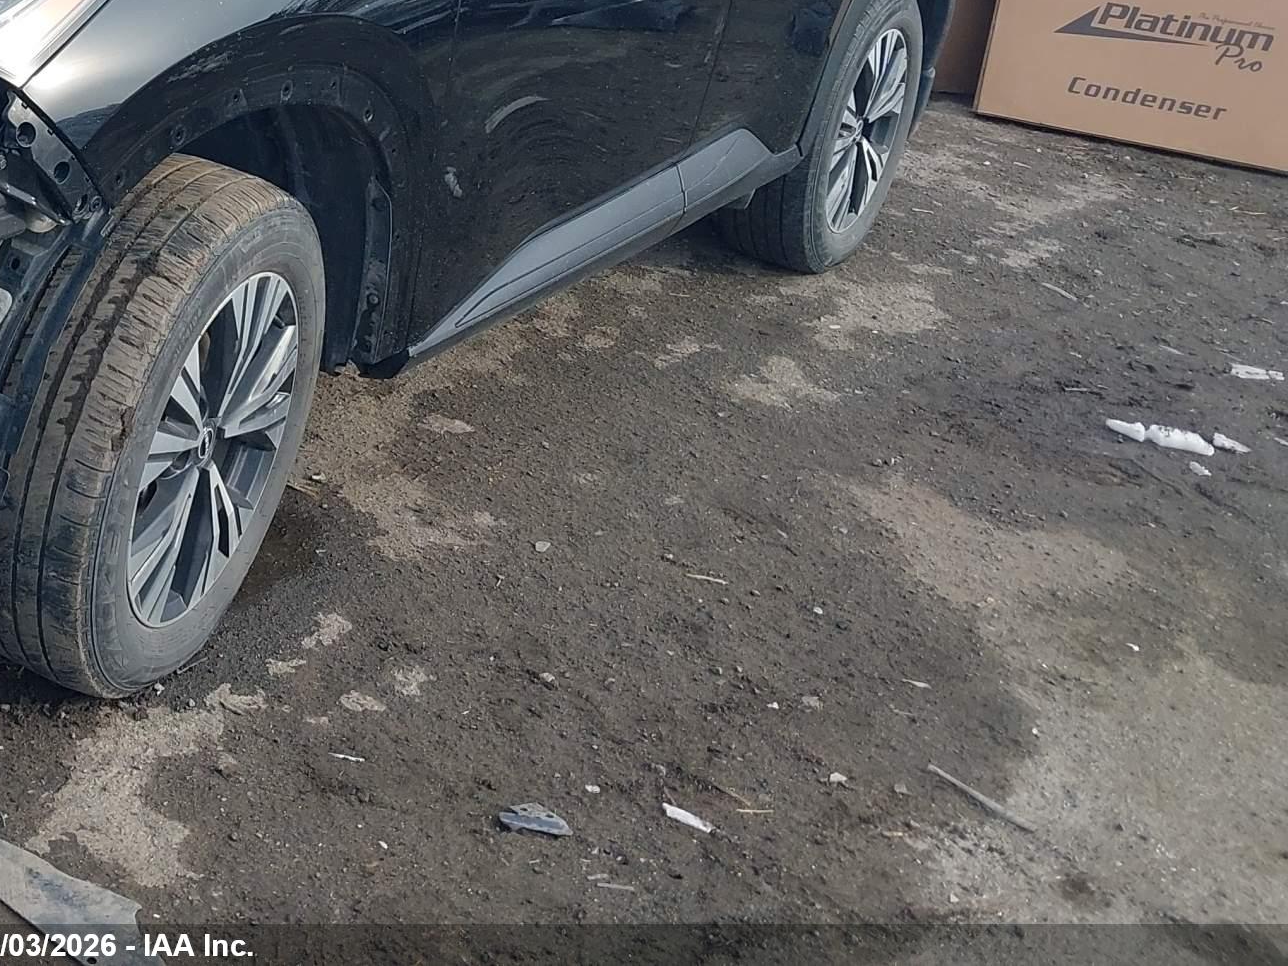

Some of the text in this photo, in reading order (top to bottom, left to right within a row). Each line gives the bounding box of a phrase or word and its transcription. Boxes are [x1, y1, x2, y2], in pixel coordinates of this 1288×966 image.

[1097, 1, 1275, 52] Platinum
[1215, 42, 1263, 73] Pro
[1067, 76, 1228, 121] Condenser
